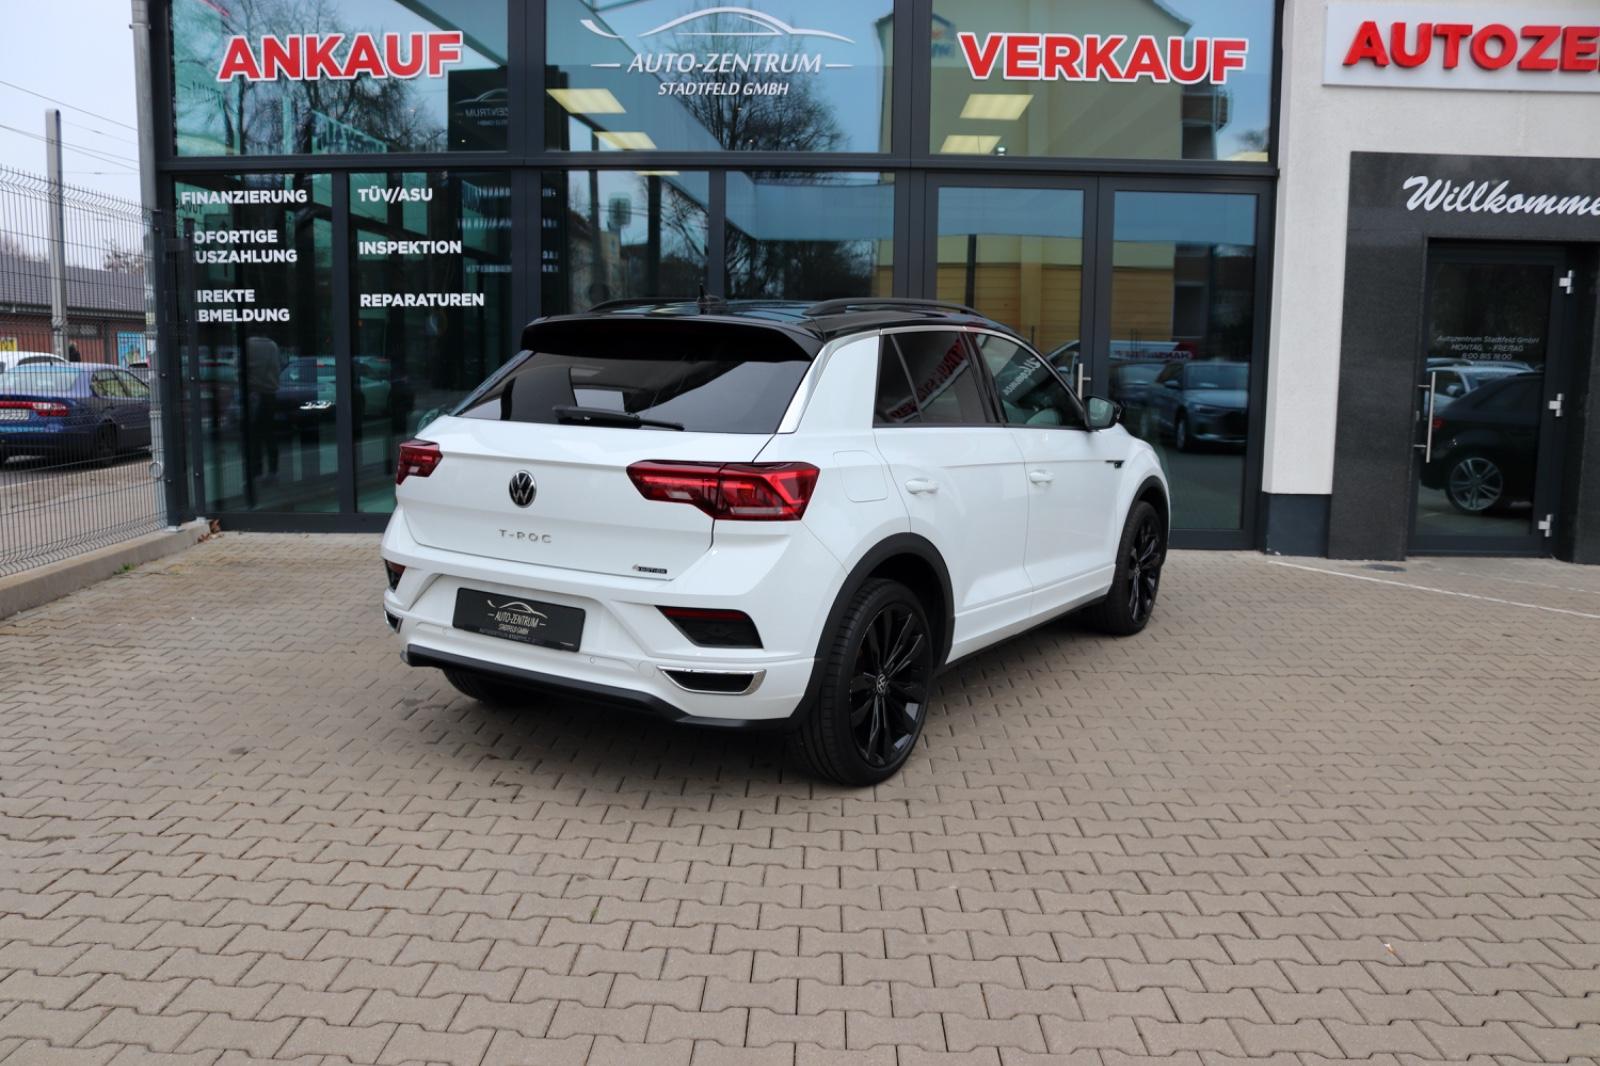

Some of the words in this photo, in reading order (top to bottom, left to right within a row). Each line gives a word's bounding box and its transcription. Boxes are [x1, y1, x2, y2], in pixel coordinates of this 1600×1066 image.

[1342, 21, 1600, 72] AUTOZE
[217, 31, 463, 82] ANKAUF
[627, 52, 822, 75] AUTO-ZENTRUM
[957, 32, 1249, 85] VERKAUF
[658, 81, 739, 97] STADTFELD
[742, 82, 789, 97] GMBH
[181, 189, 308, 205] FINANZIERUNG
[358, 185, 433, 203] TÜV/ASU
[194, 229, 278, 244] OFORTIGE
[359, 240, 462, 255] INSPEKTION
[194, 249, 298, 264] USZAHLUNG
[195, 288, 256, 303] IREKTE
[360, 292, 485, 308] REPARATUREN
[197, 308, 290, 322] BMELDUNG
